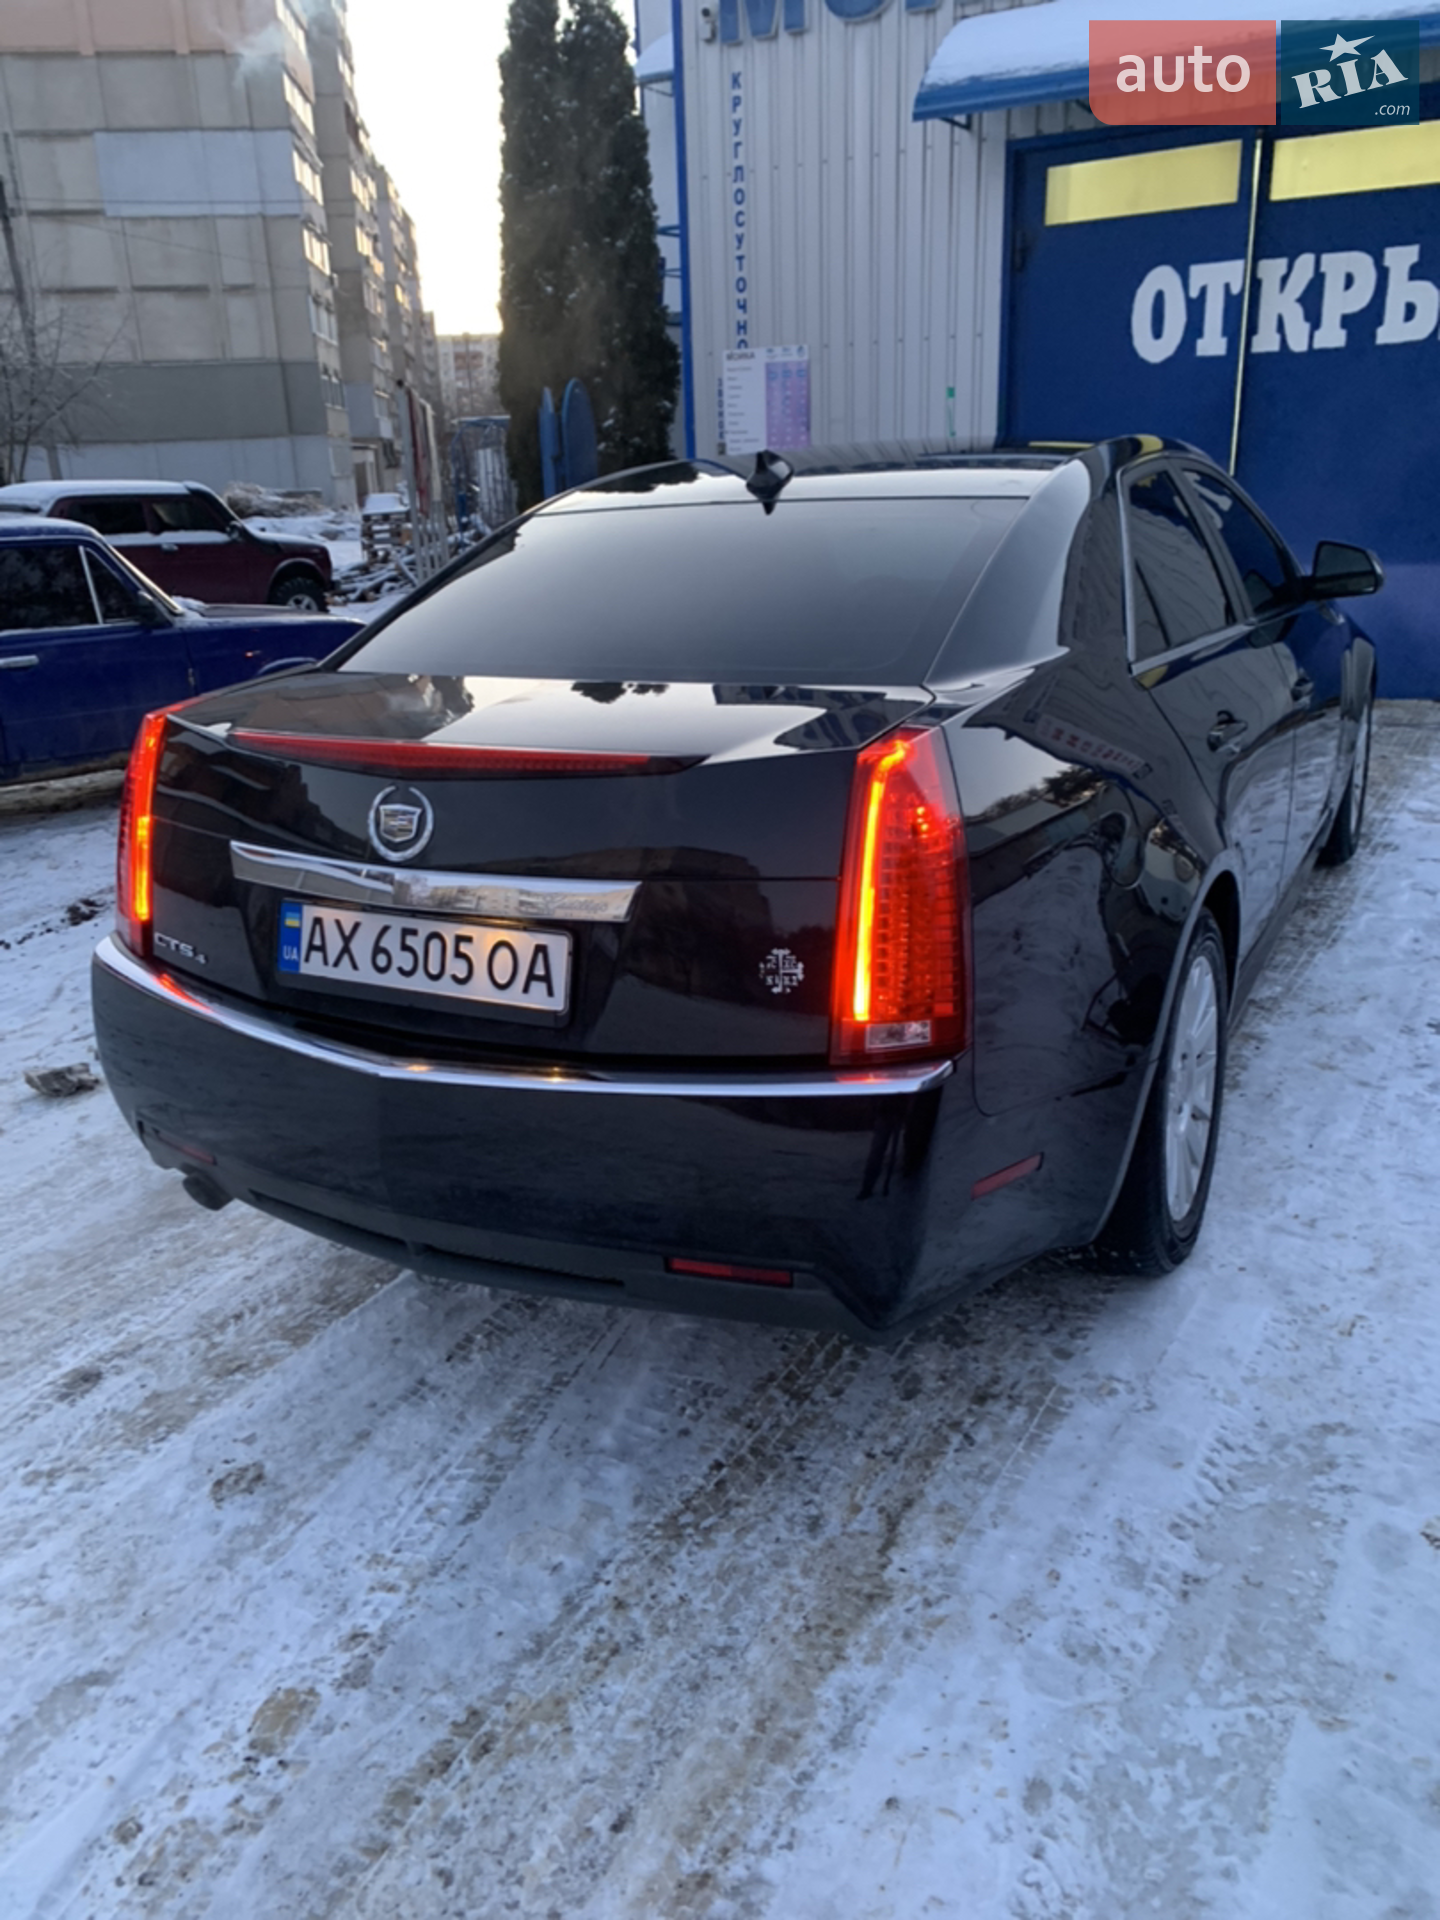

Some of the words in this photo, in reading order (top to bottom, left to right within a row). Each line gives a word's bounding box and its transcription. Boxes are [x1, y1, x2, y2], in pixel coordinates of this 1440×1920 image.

[154, 932, 195, 958] CTS
[283, 946, 299, 961] UA
[303, 916, 362, 972] AX
[371, 925, 474, 986] 6505
[487, 939, 555, 998] OA
